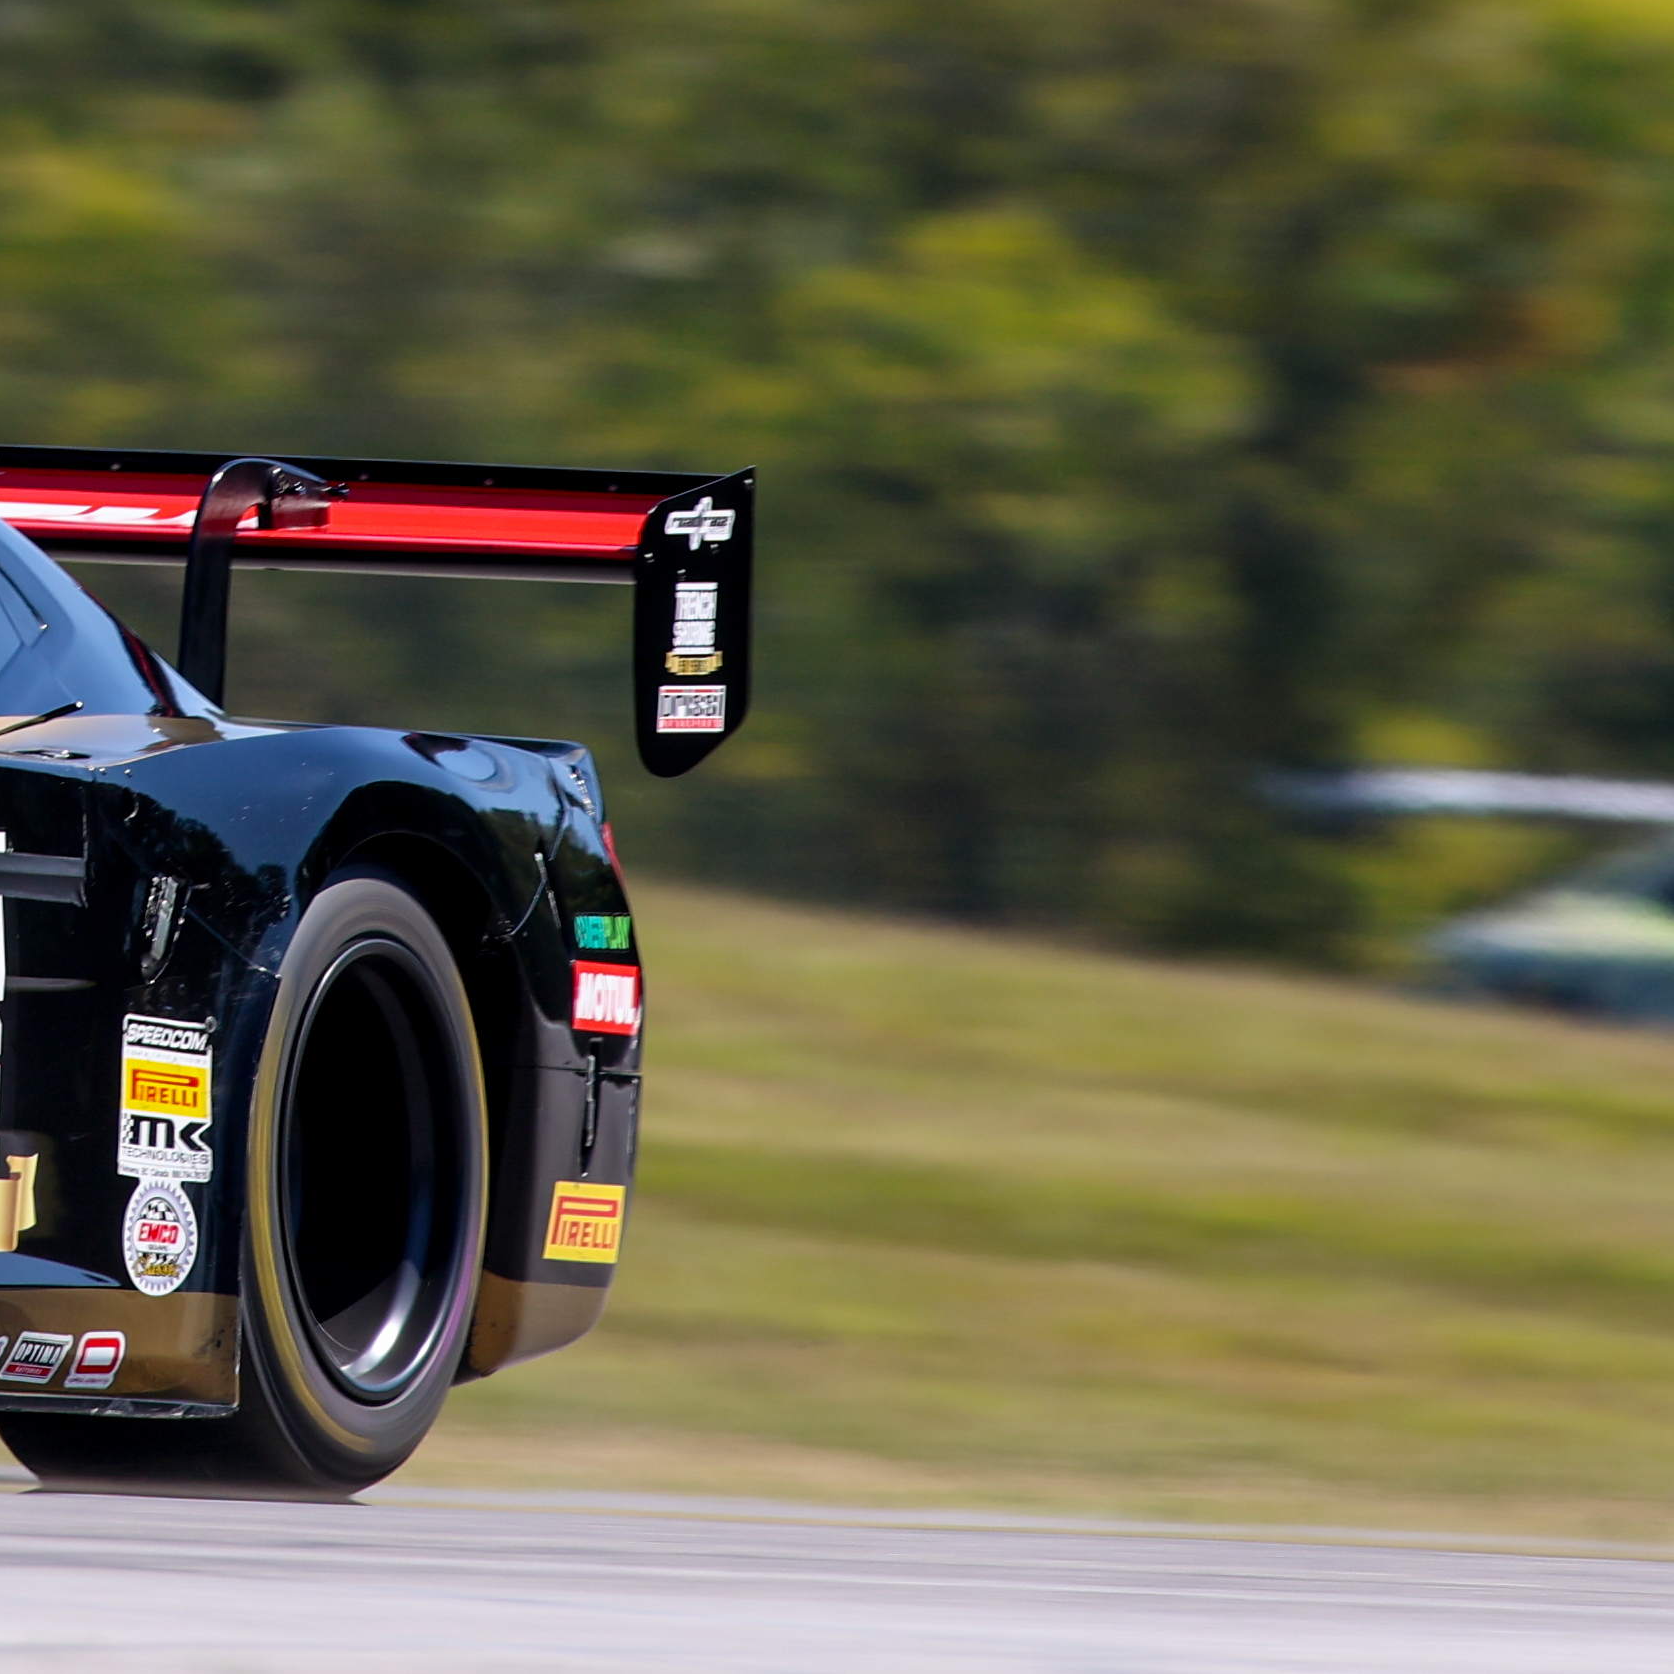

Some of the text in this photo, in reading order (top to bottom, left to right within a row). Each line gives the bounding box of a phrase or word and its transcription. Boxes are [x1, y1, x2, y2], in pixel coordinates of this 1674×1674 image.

[575, 972, 637, 1025] MOTUL
[127, 1023, 209, 1051] SPEEDCOM
[131, 1069, 199, 1108] PIRELLI
[122, 1145, 209, 1165] TECHNOLOGIES
[551, 1196, 618, 1249] PIRELLI
[14, 1342, 63, 1364] OPTIMA
